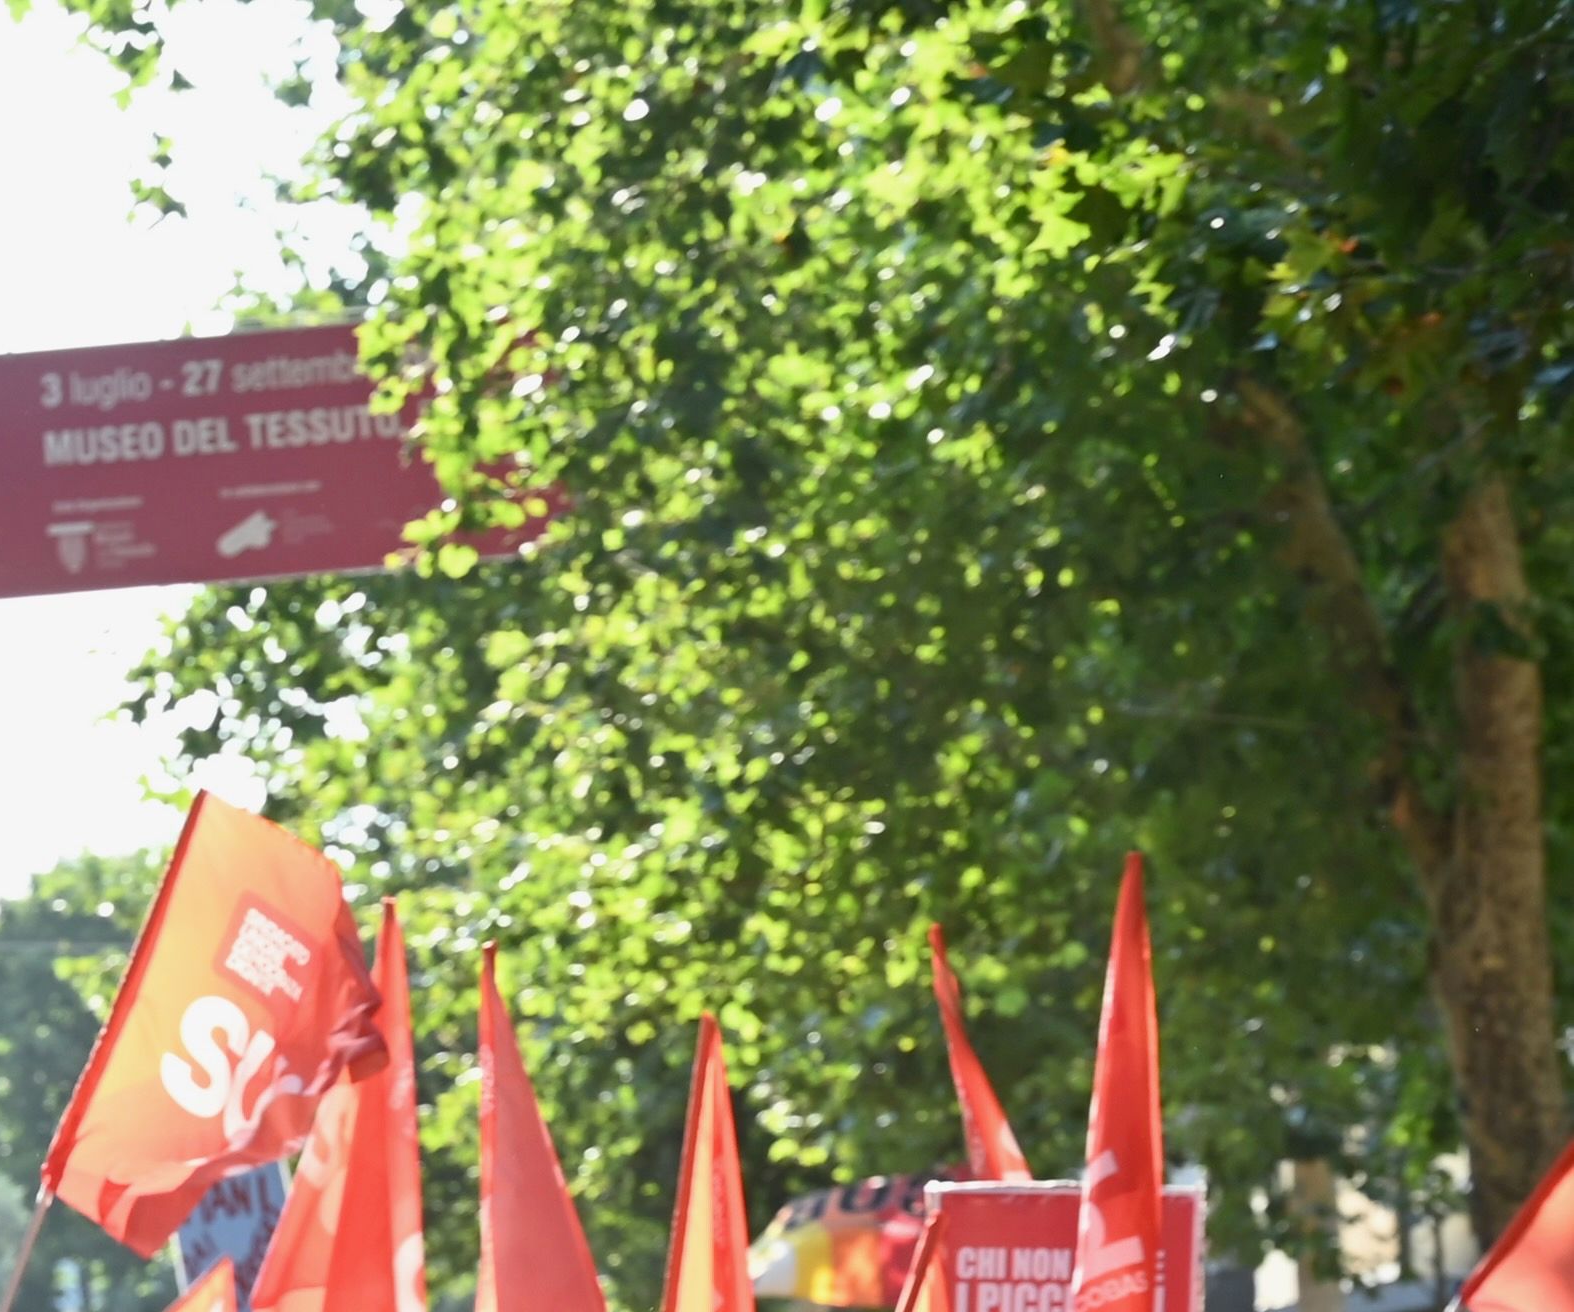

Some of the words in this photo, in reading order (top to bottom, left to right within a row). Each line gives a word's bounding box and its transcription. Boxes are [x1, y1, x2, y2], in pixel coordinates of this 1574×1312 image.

[40, 372, 62, 408] 3
[70, 369, 151, 410] luglio
[182, 361, 222, 397] 27
[231, 349, 357, 392] settemb
[44, 422, 164, 466] MUSEO
[173, 415, 237, 457] DEL
[244, 404, 401, 448] TESSUTO
[955, 1246, 1007, 1281] CHI
[1010, 1247, 1072, 1281] NON
